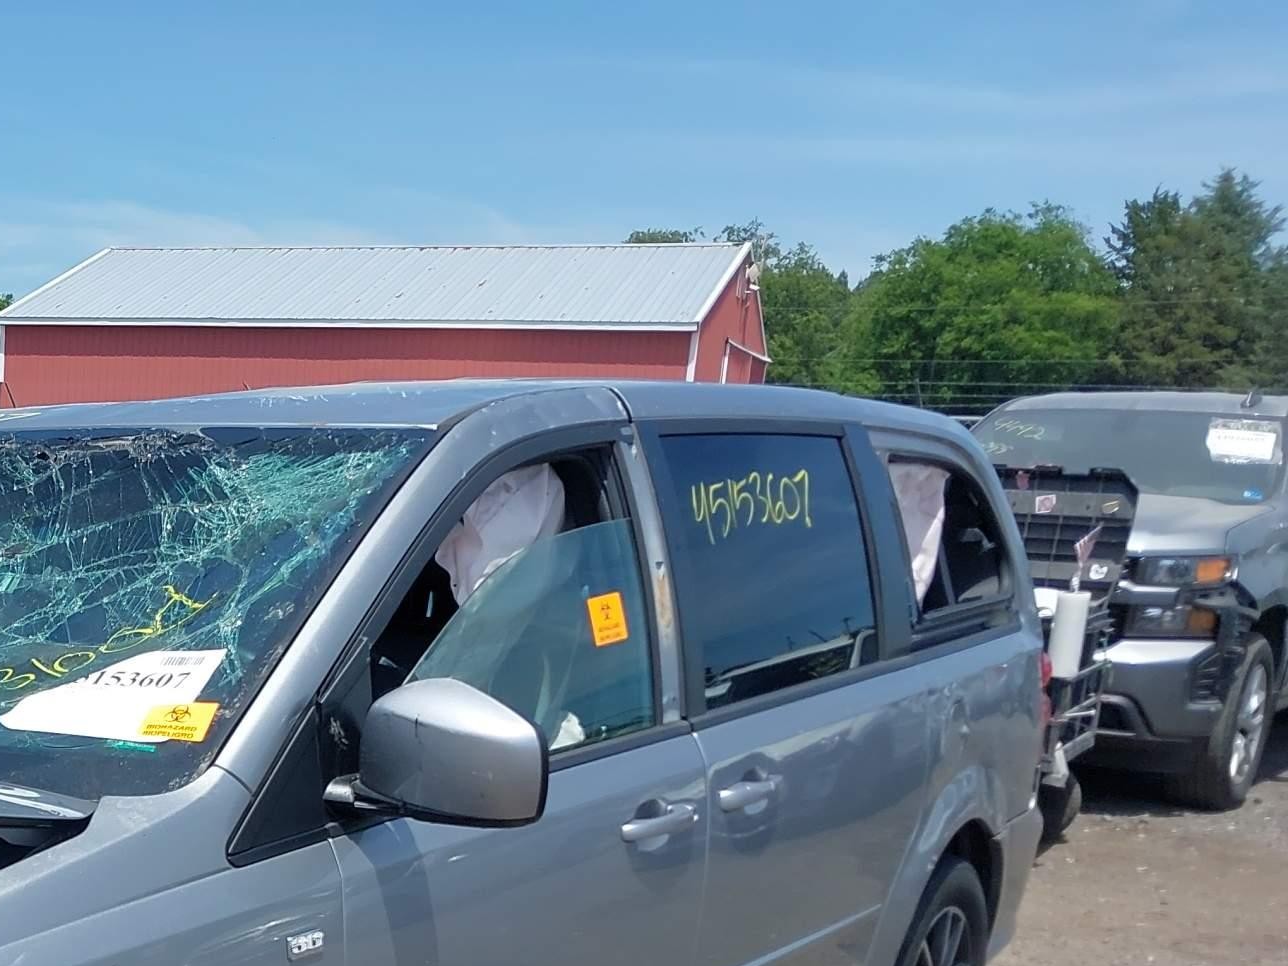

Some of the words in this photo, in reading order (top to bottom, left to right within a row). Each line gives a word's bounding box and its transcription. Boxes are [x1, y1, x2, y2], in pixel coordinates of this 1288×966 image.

[691, 468, 812, 545] 45153607
[74, 670, 192, 690] 153607
[142, 730, 194, 739] BIOPELIGRO
[146, 724, 198, 732] BIOHAZARD
